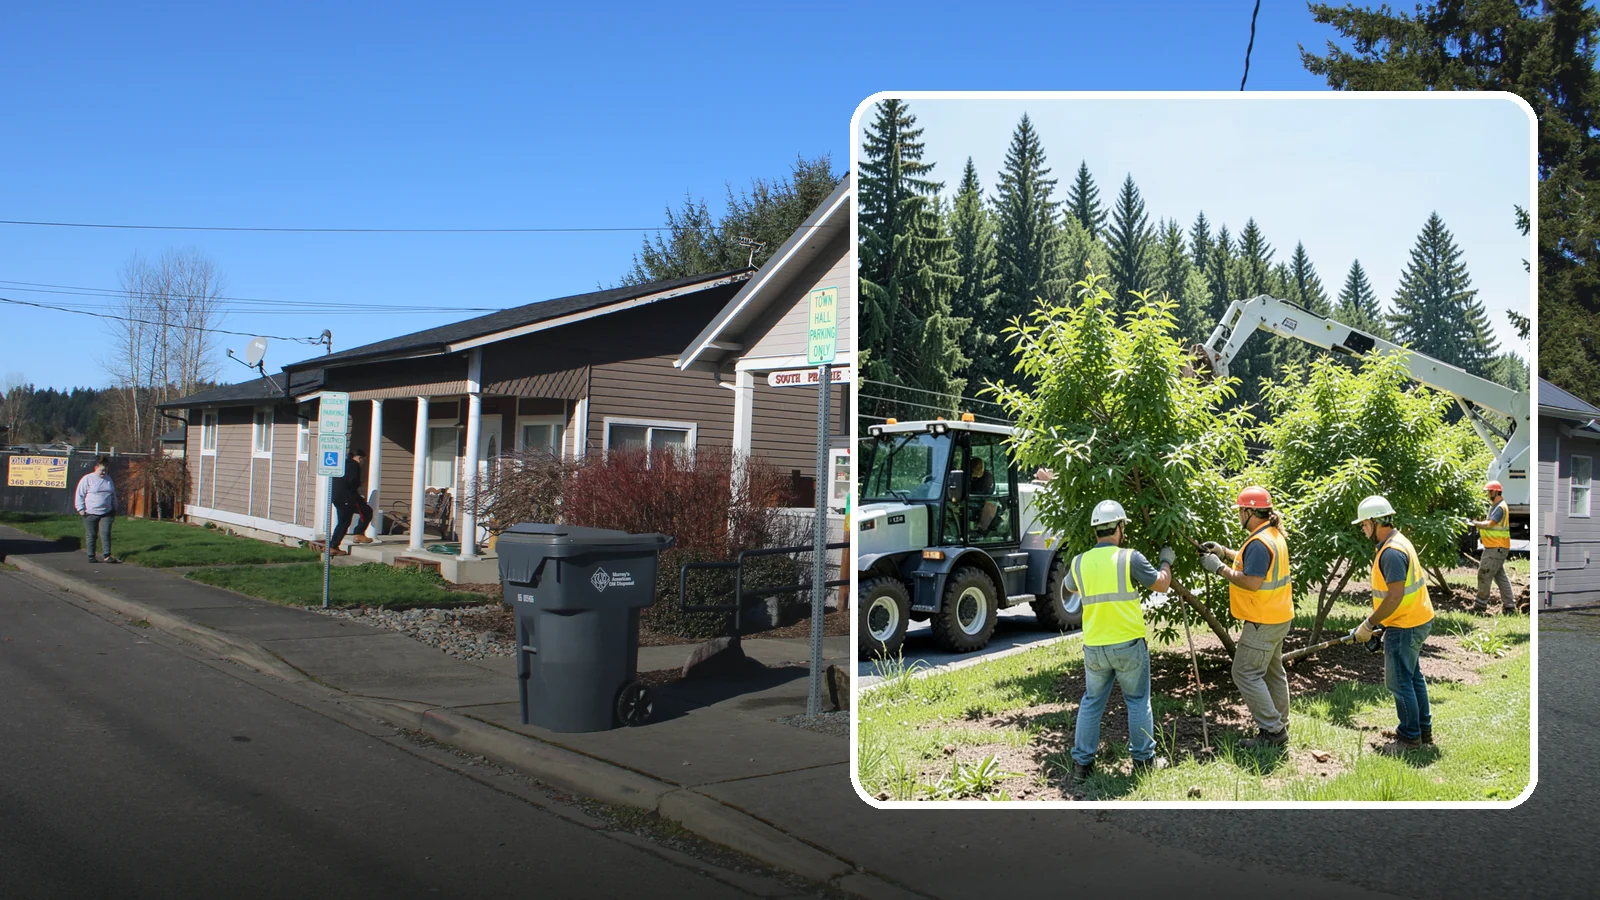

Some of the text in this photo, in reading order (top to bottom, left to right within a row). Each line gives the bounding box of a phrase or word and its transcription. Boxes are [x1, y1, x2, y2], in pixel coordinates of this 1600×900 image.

[815, 295, 832, 308] TOWN
[814, 312, 830, 324] HALL
[810, 326, 836, 340] PARKING
[814, 344, 830, 357] ONLY
[776, 374, 801, 384] SOUTH
[808, 370, 842, 382] PRRIE
